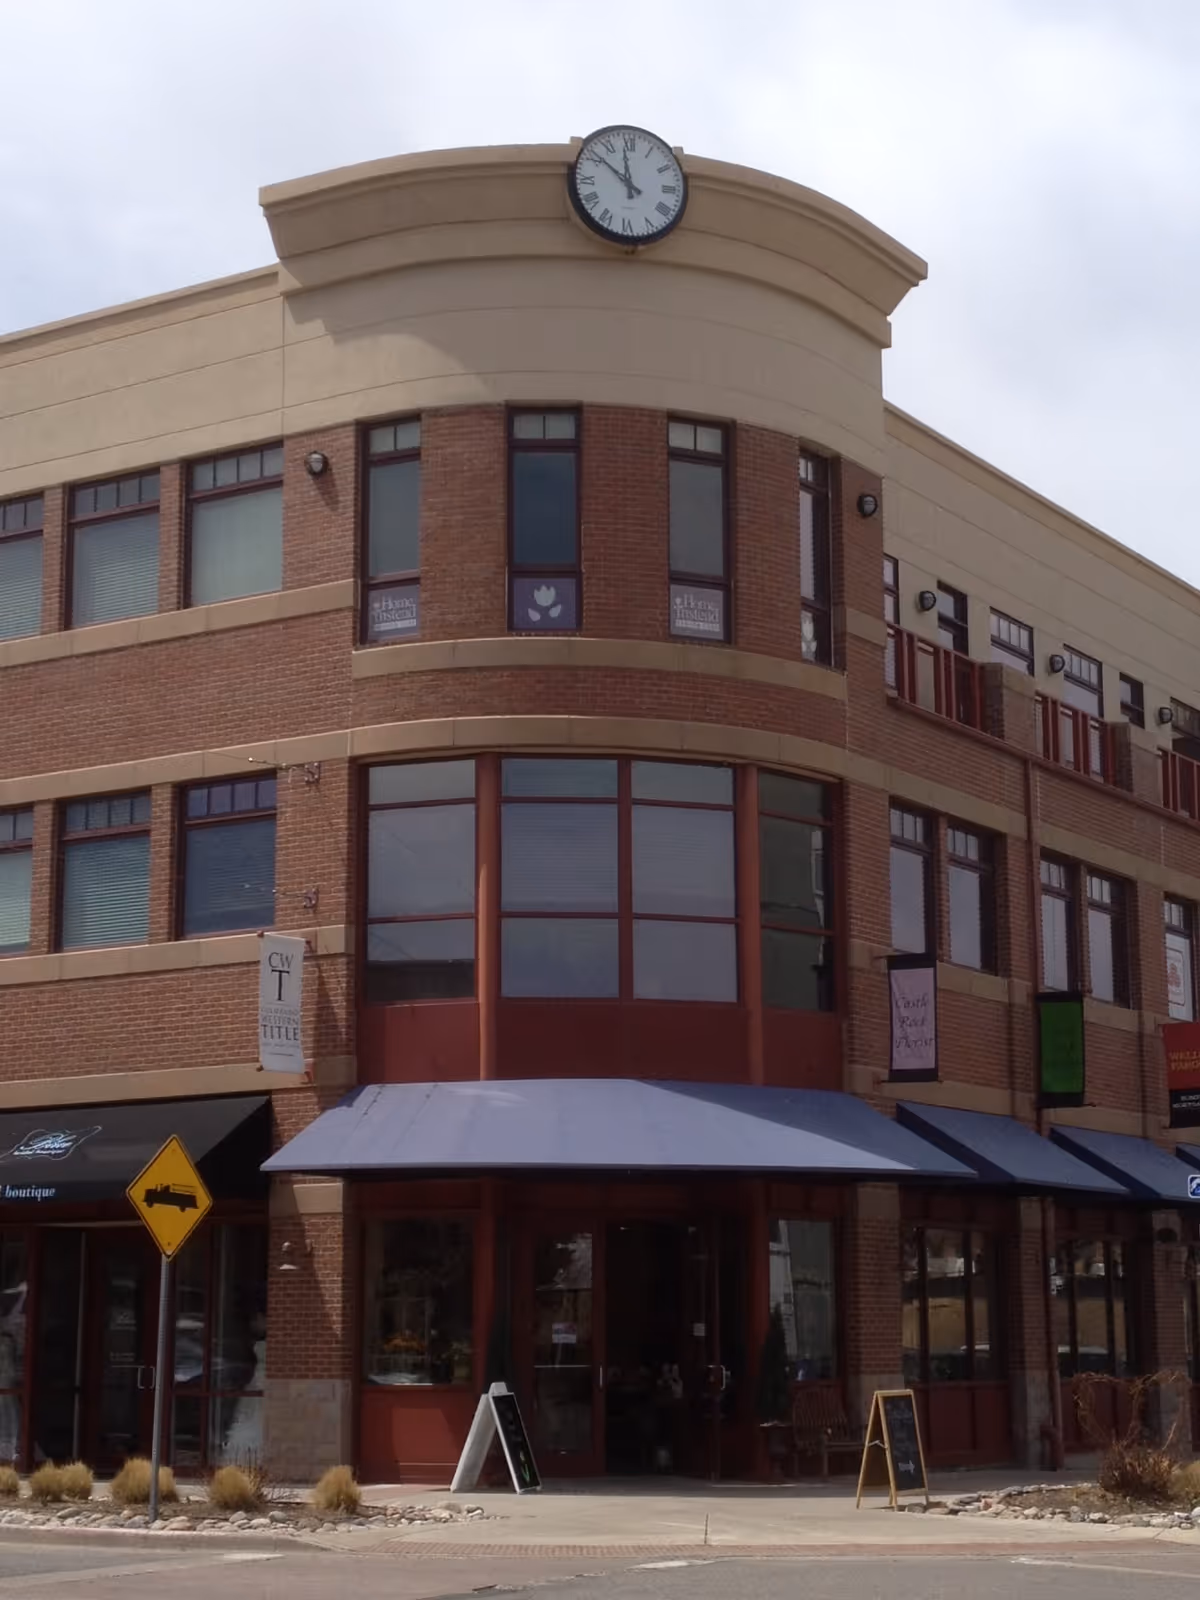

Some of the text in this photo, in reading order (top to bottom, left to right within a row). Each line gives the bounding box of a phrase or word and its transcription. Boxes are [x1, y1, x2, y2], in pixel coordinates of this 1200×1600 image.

[267, 951, 294, 969] CW
[271, 968, 291, 1002] T
[260, 1023, 300, 1042] TITLE
[4, 1184, 56, 1202] boutique
